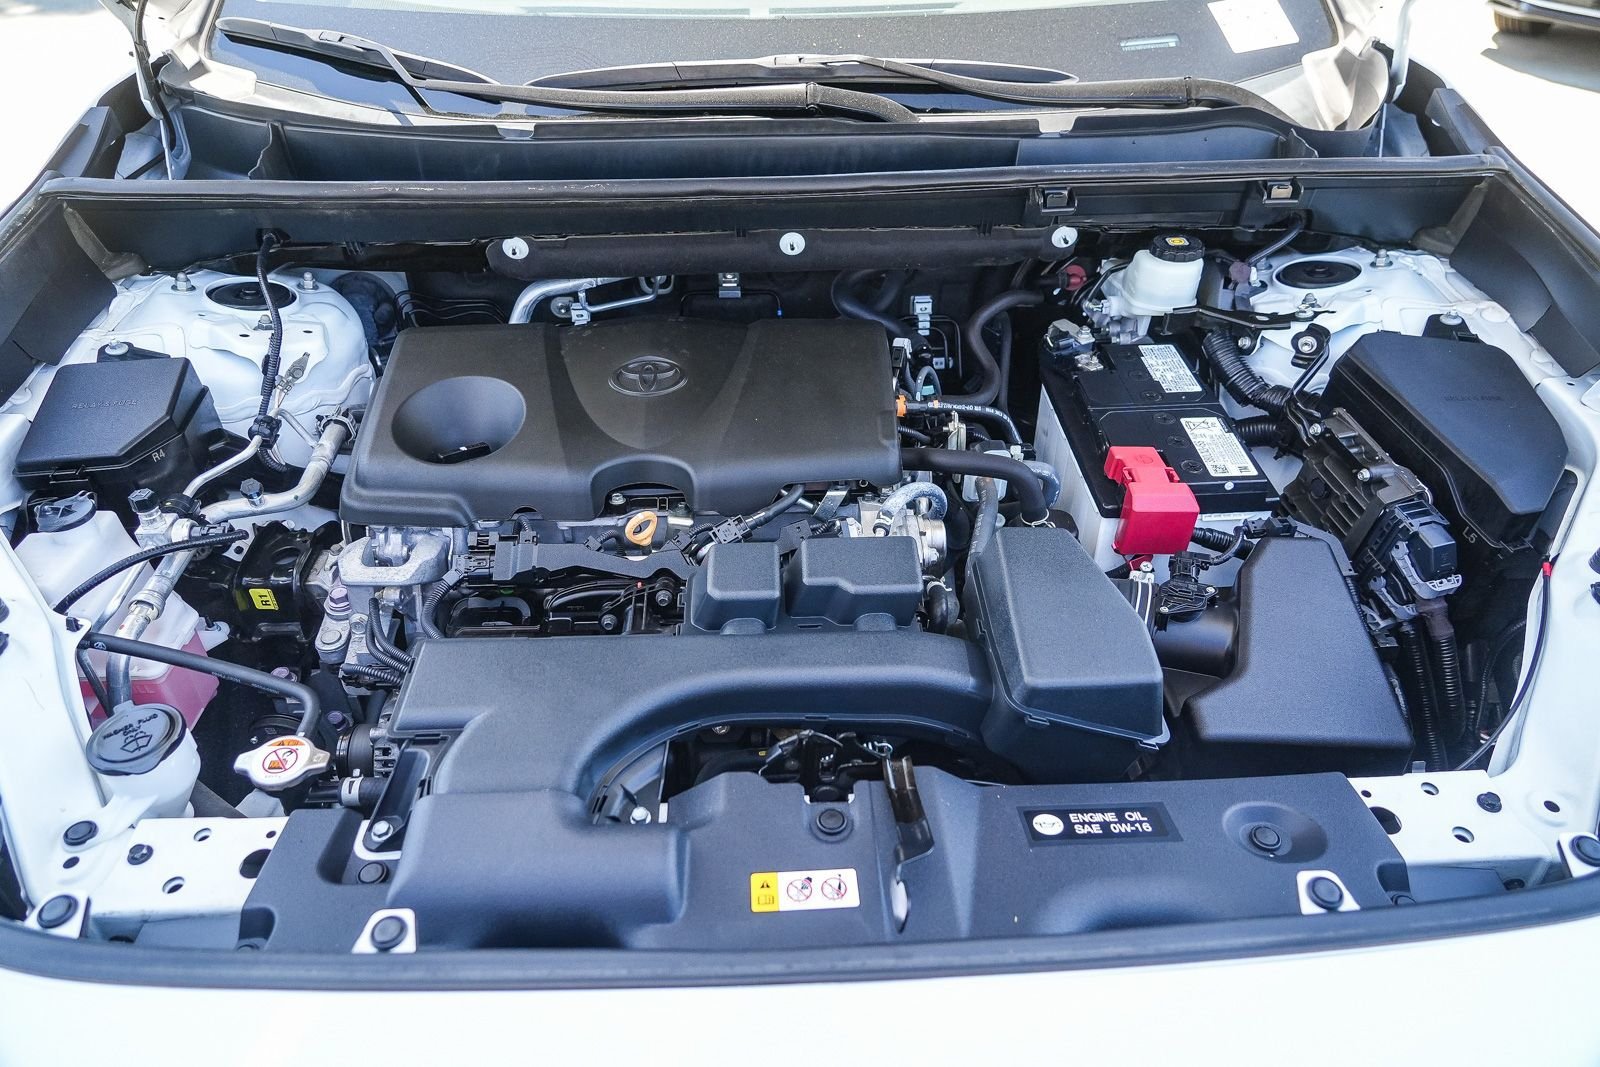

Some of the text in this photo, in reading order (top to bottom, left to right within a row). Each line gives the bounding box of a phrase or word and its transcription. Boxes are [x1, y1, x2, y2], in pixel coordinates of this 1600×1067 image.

[151, 449, 165, 462] R4
[1462, 526, 1477, 543] L5
[258, 595, 271, 606] R1
[1069, 811, 1148, 823] ENGINE OIL
[1074, 822, 1152, 834] SAE 0W-16
